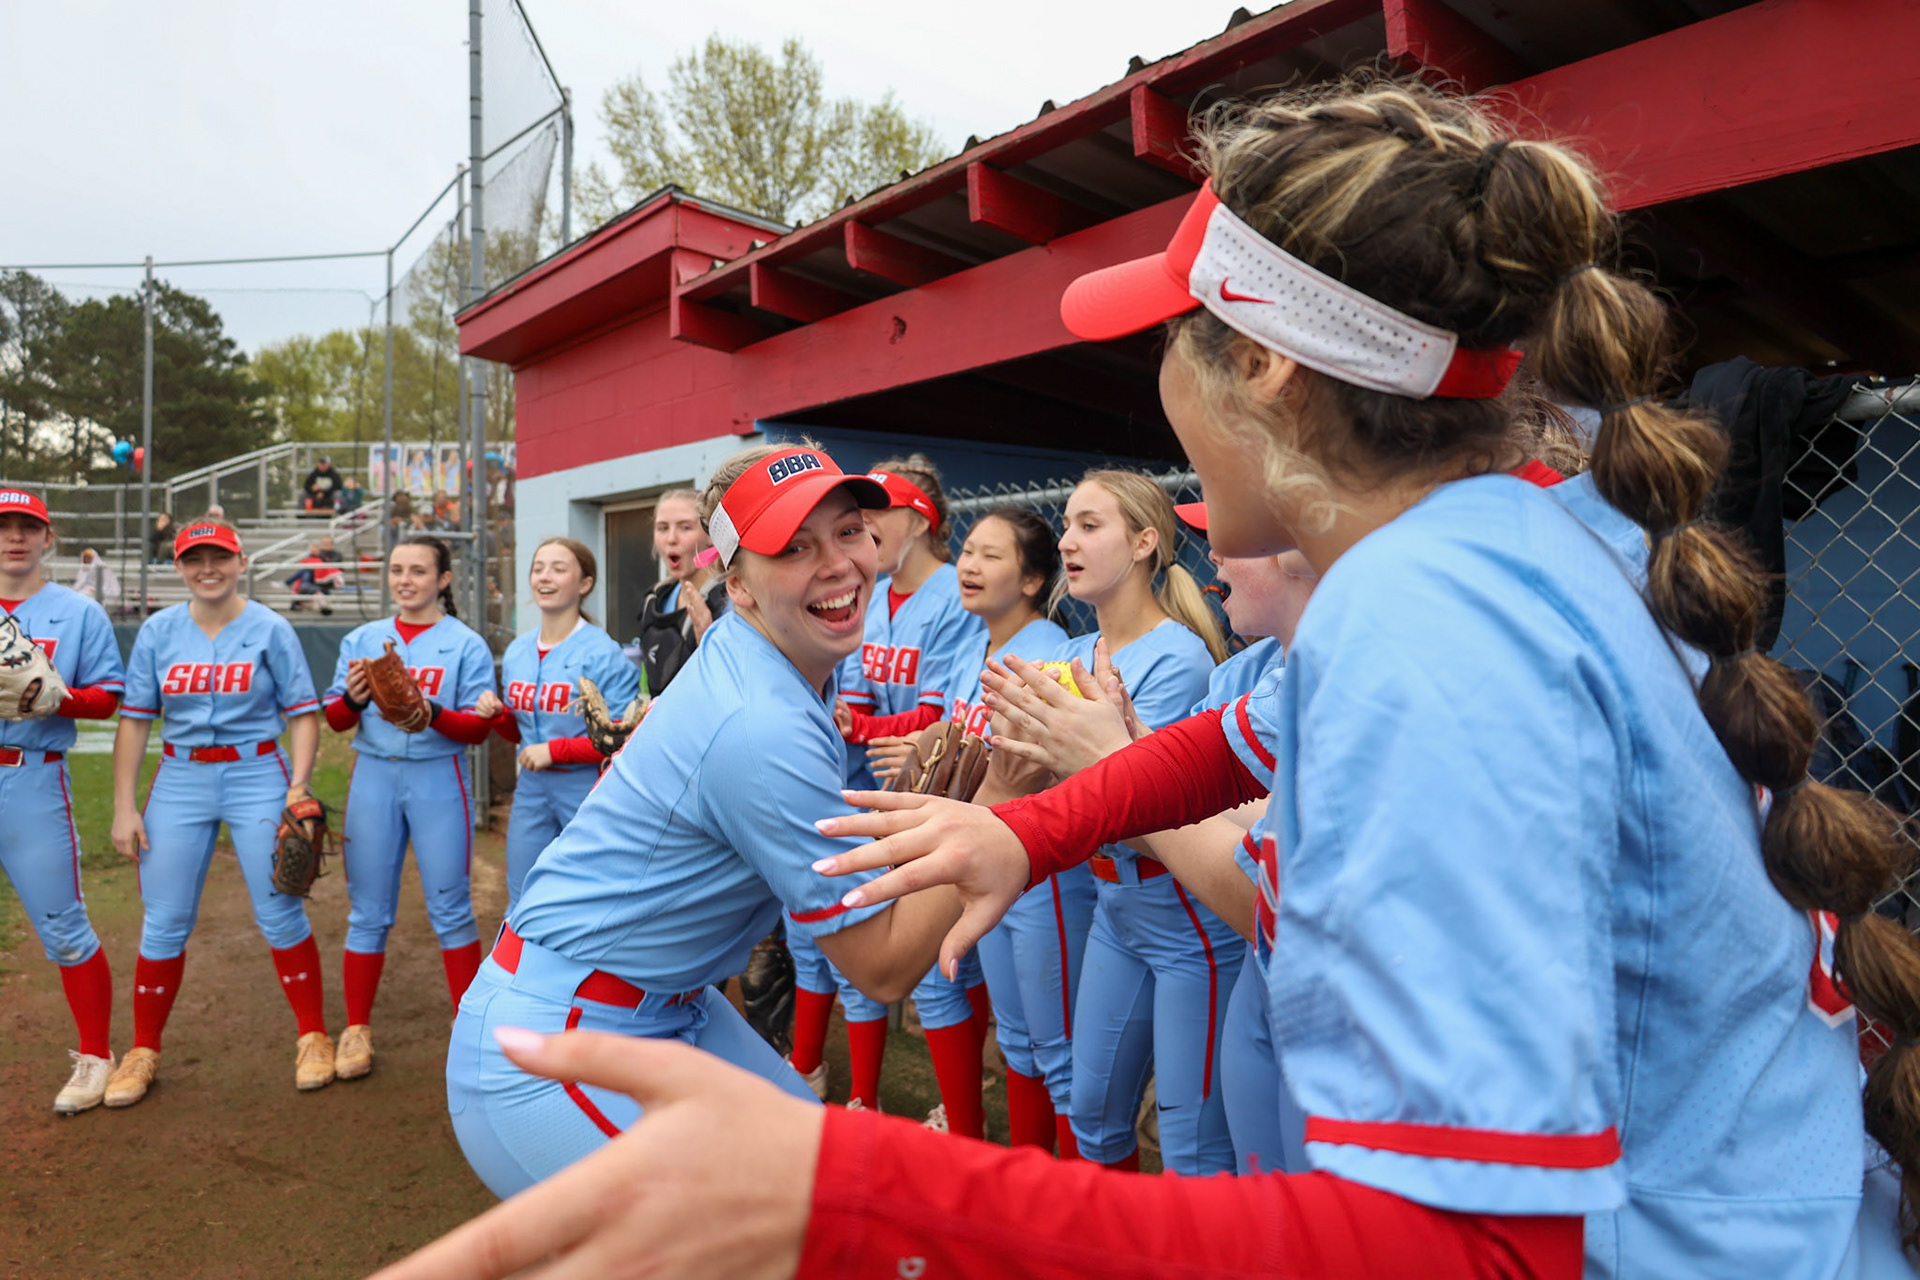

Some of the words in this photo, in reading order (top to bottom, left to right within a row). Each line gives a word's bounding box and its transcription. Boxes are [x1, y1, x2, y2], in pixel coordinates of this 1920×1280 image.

[767, 453, 824, 486] SBA
[161, 661, 254, 696] SBA
[861, 642, 922, 687] SBA
[508, 680, 573, 715] SBA
